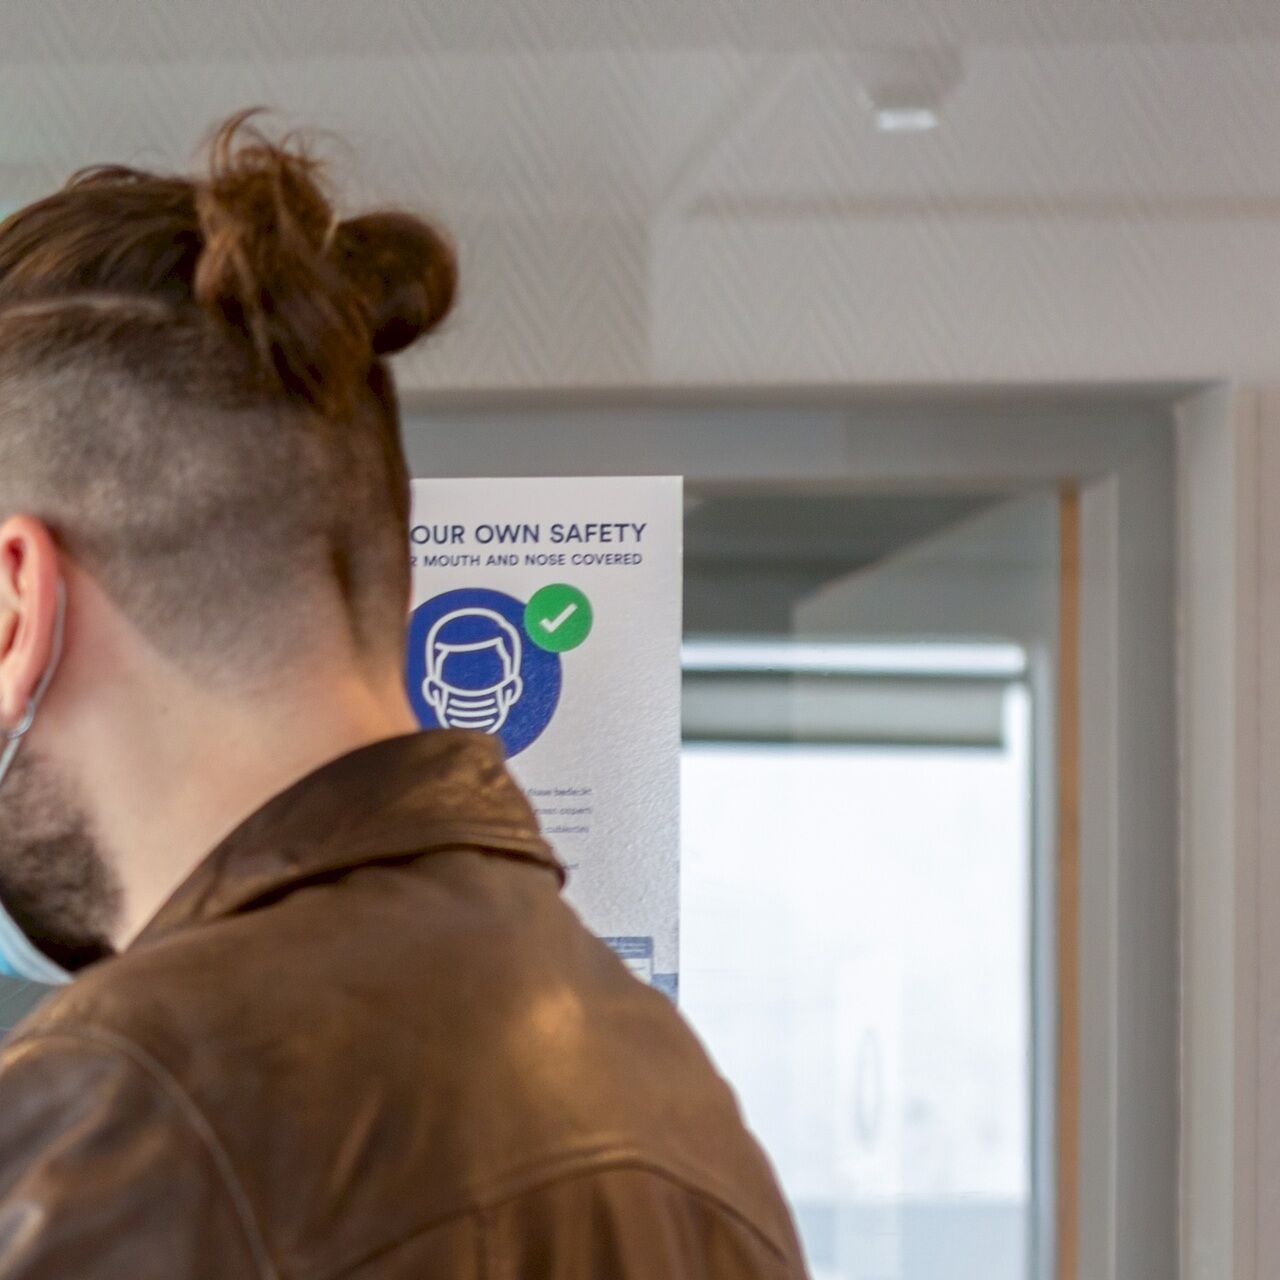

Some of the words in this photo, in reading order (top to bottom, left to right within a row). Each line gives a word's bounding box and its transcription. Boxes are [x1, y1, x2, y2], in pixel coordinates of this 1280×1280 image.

[475, 524, 540, 544] OWN
[550, 523, 647, 544] SAFETY
[424, 555, 480, 567] MOUTH
[486, 554, 519, 566] AND
[525, 554, 566, 566] NOSE
[571, 553, 643, 566] COVERED
